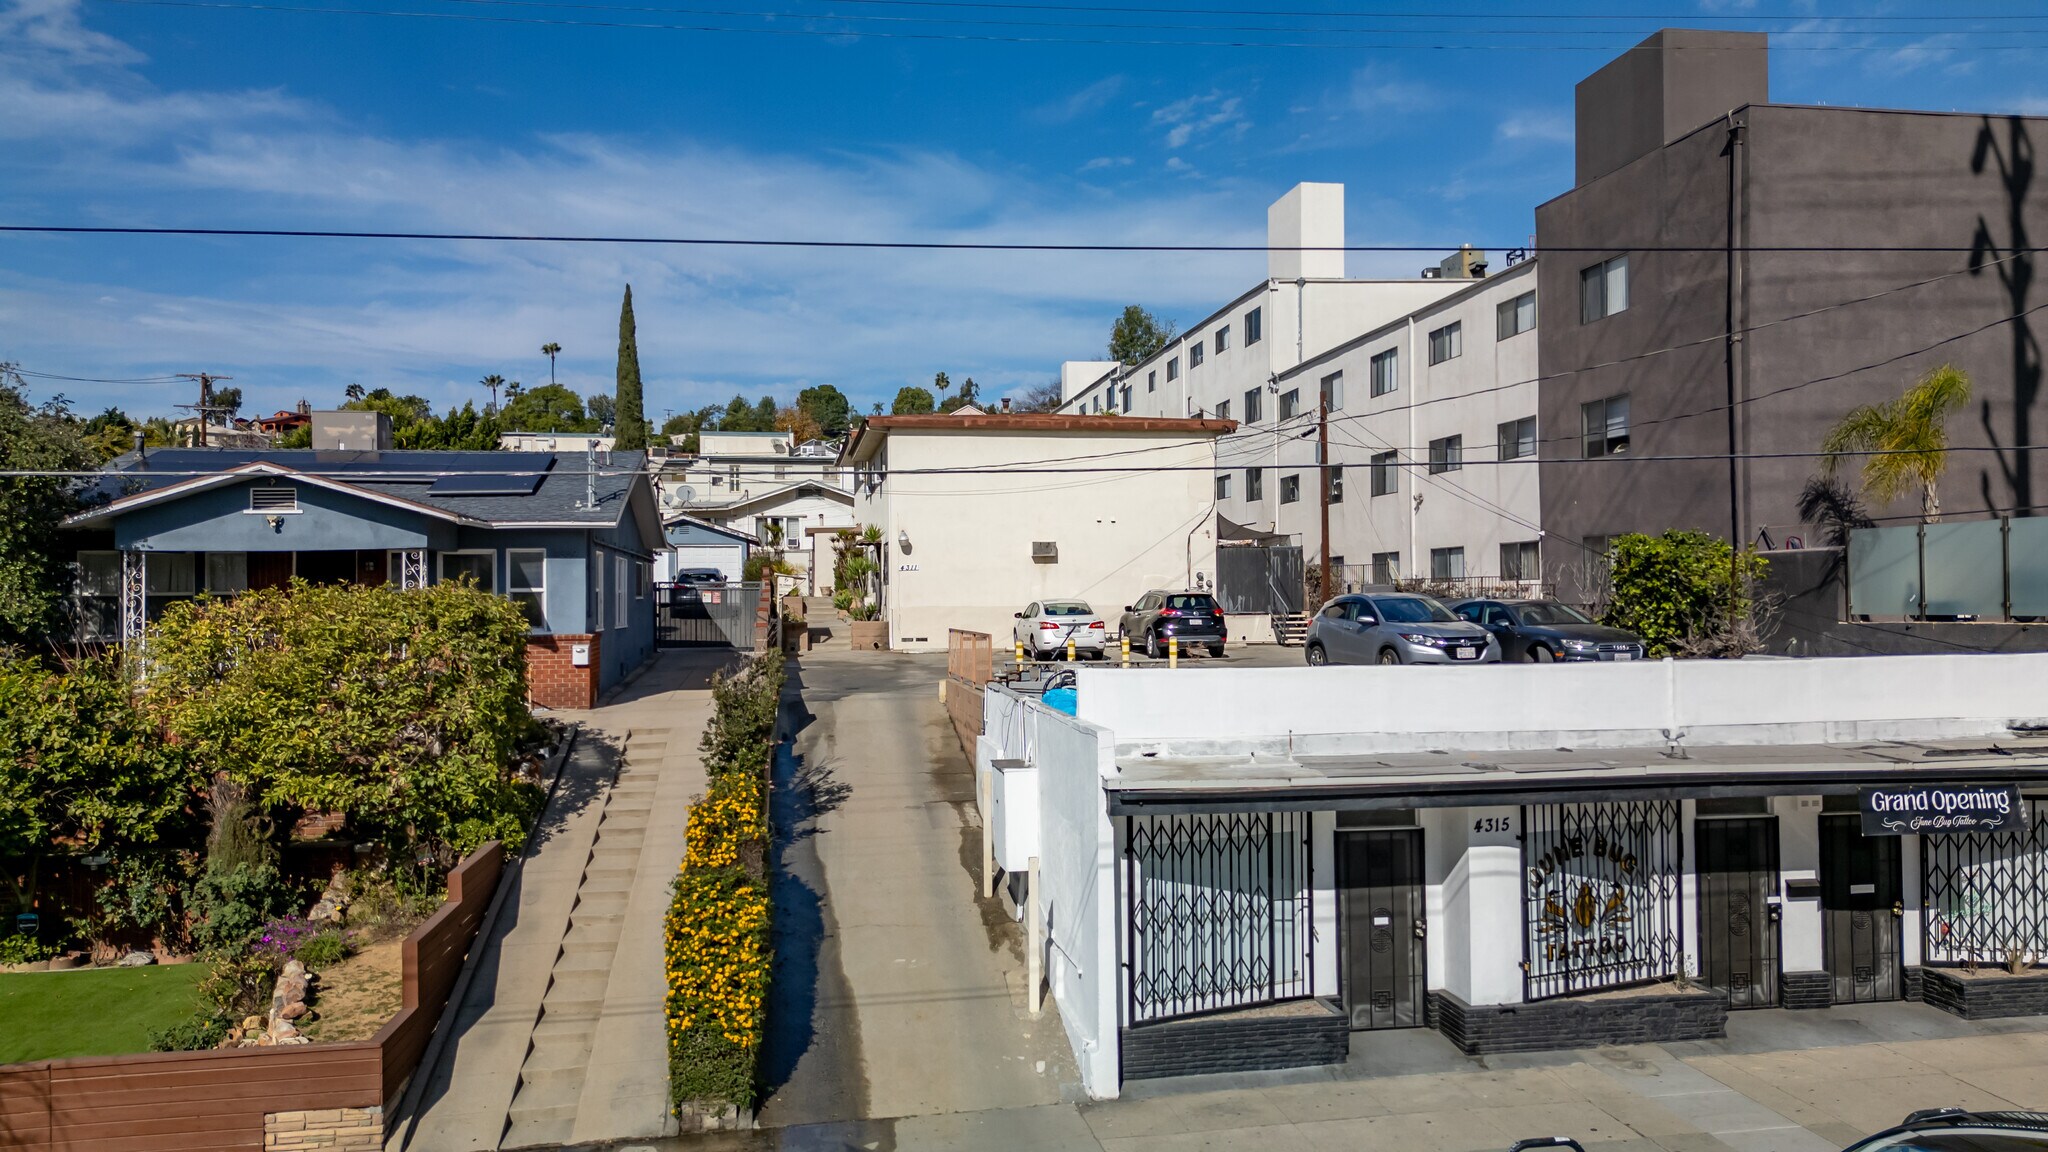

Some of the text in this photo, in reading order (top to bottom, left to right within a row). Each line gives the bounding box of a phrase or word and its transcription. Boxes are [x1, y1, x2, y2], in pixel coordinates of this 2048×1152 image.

[1871, 789, 2010, 814] Grand Opening
[1474, 817, 1510, 833] 4315
[1910, 814, 1977, 831] June Bug Tattoo
[1530, 835, 1637, 888] JUNE BUG
[1546, 934, 1627, 961] TATTOO
